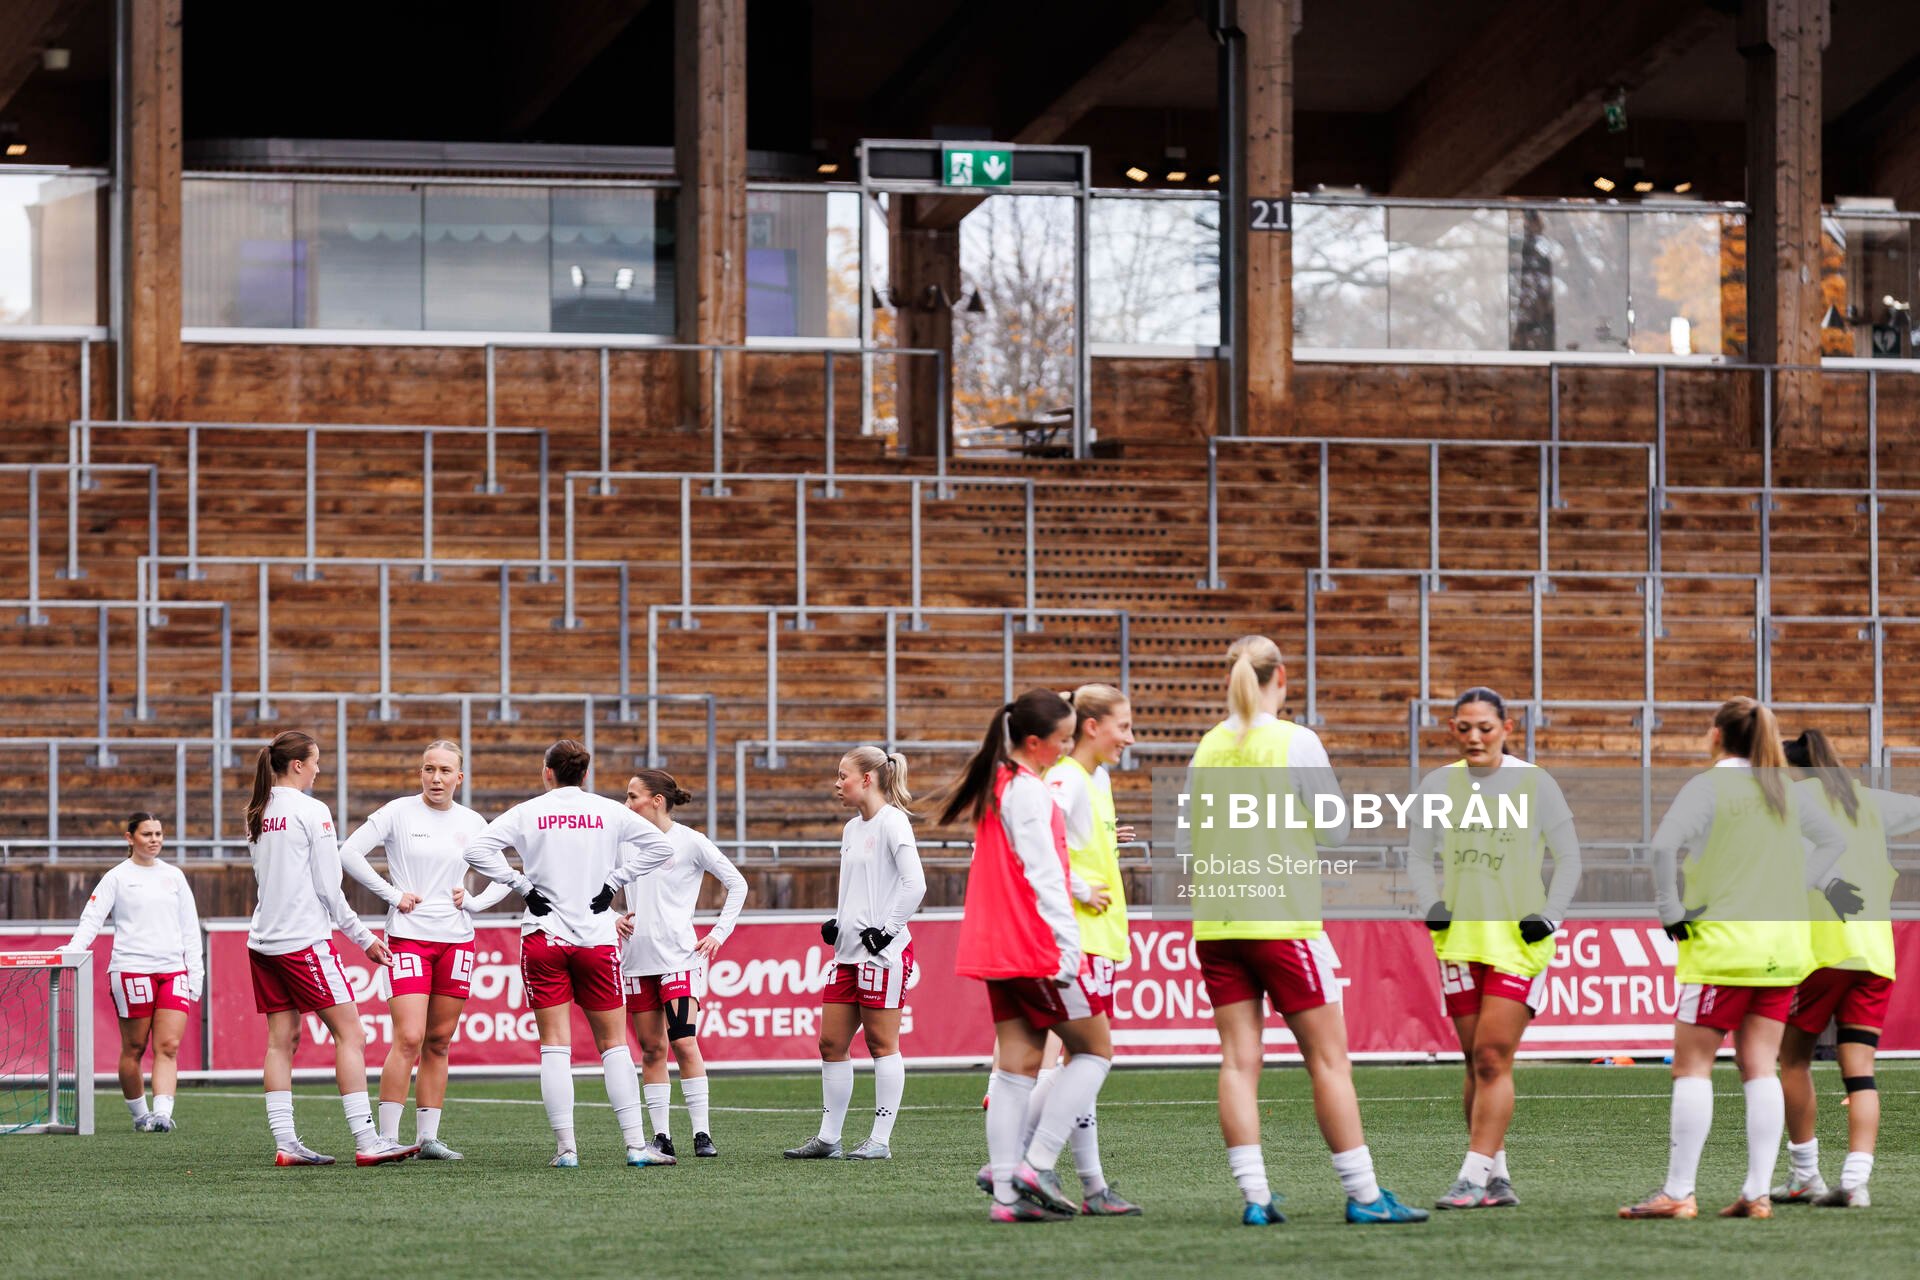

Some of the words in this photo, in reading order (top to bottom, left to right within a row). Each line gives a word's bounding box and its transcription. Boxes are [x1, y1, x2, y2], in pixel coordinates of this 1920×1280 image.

[1251, 200, 1288, 229] 21
[262, 816, 288, 832] SALA
[538, 814, 603, 830] UPPSALA
